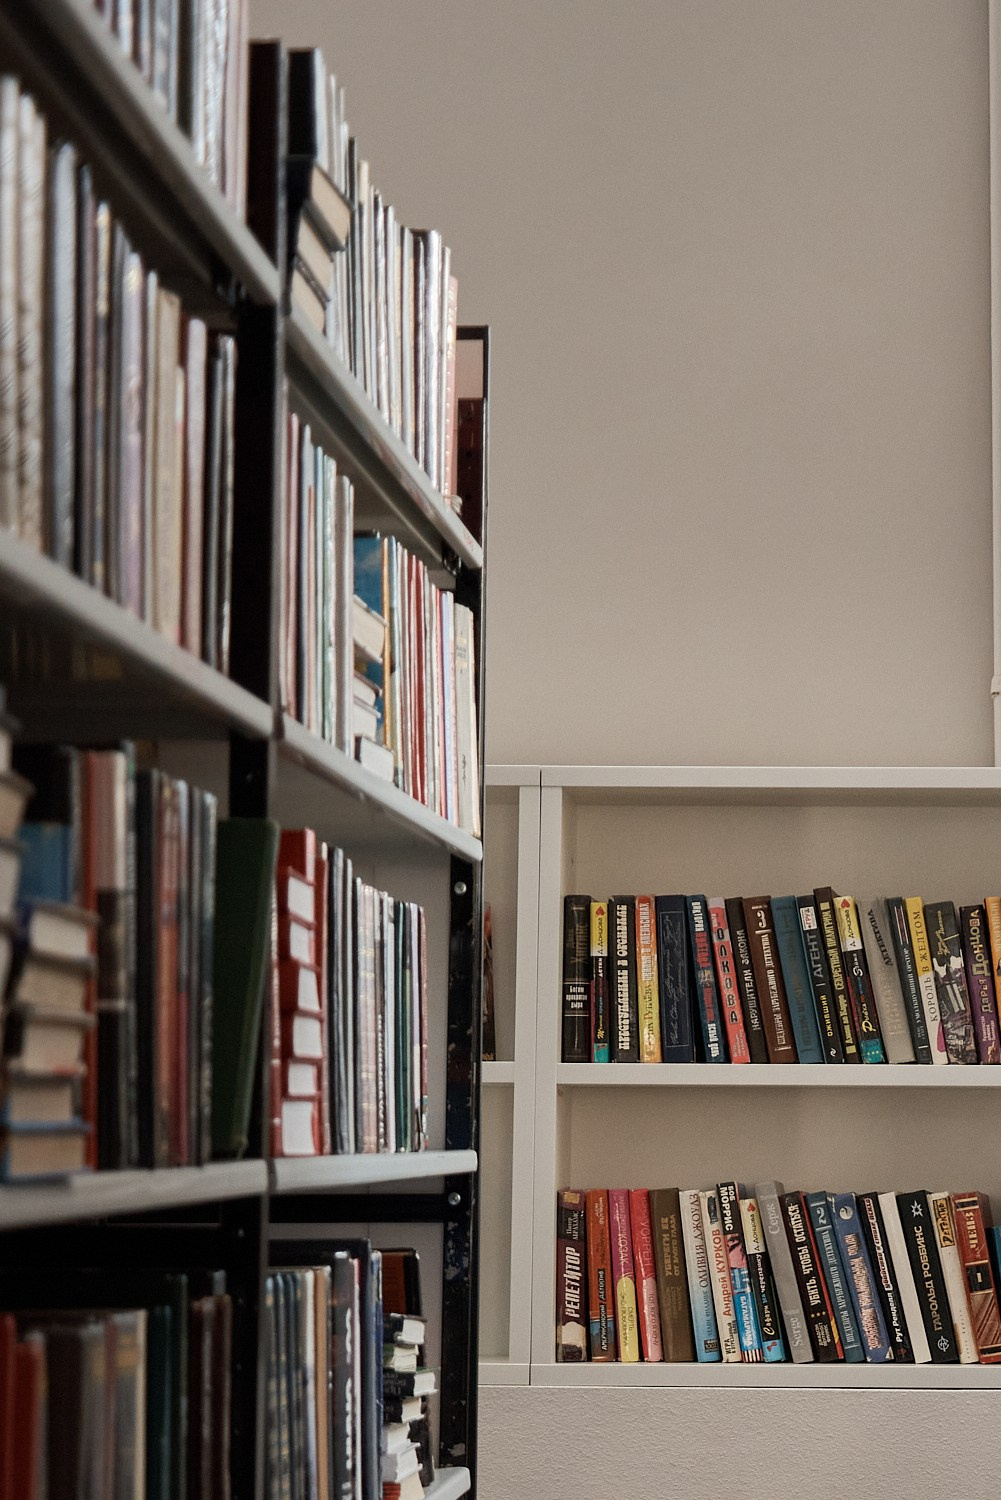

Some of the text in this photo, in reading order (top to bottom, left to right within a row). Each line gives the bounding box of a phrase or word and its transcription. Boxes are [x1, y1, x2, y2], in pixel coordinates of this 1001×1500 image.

[807, 932, 824, 978] АГЕНТ
[867, 908, 894, 967] ДЕТЕКТИВА
[912, 910, 927, 961] ЖЕЛТОМ
[736, 928, 761, 1031] НАРУШИТЕЛИ ЗАКОНА
[923, 976, 938, 1023] КОРОЛЬ
[819, 994, 834, 1037] ОЖИВШИЙ
[720, 1185, 733, 1231] МОРРИС
[727, 1185, 735, 1202] БОБ
[691, 1193, 704, 1241] ДЖОУЛЗ
[768, 1202, 781, 1235] Серж
[788, 1202, 806, 1241] ОСТАТЬСЯ
[696, 1242, 710, 1288] ОЛИВИЯ
[713, 1228, 732, 1317] Андрей КУРКОВ
[801, 1240, 814, 1274] ЧТОБЫ
[915, 1225, 944, 1332] ГАРОЛЬД РОББИНС
[565, 1246, 583, 1319] РЕПЕТИТОР
[791, 1314, 804, 1349] Serge
[888, 1292, 900, 1325] Ренделл
[894, 1325, 904, 1343] Рут
